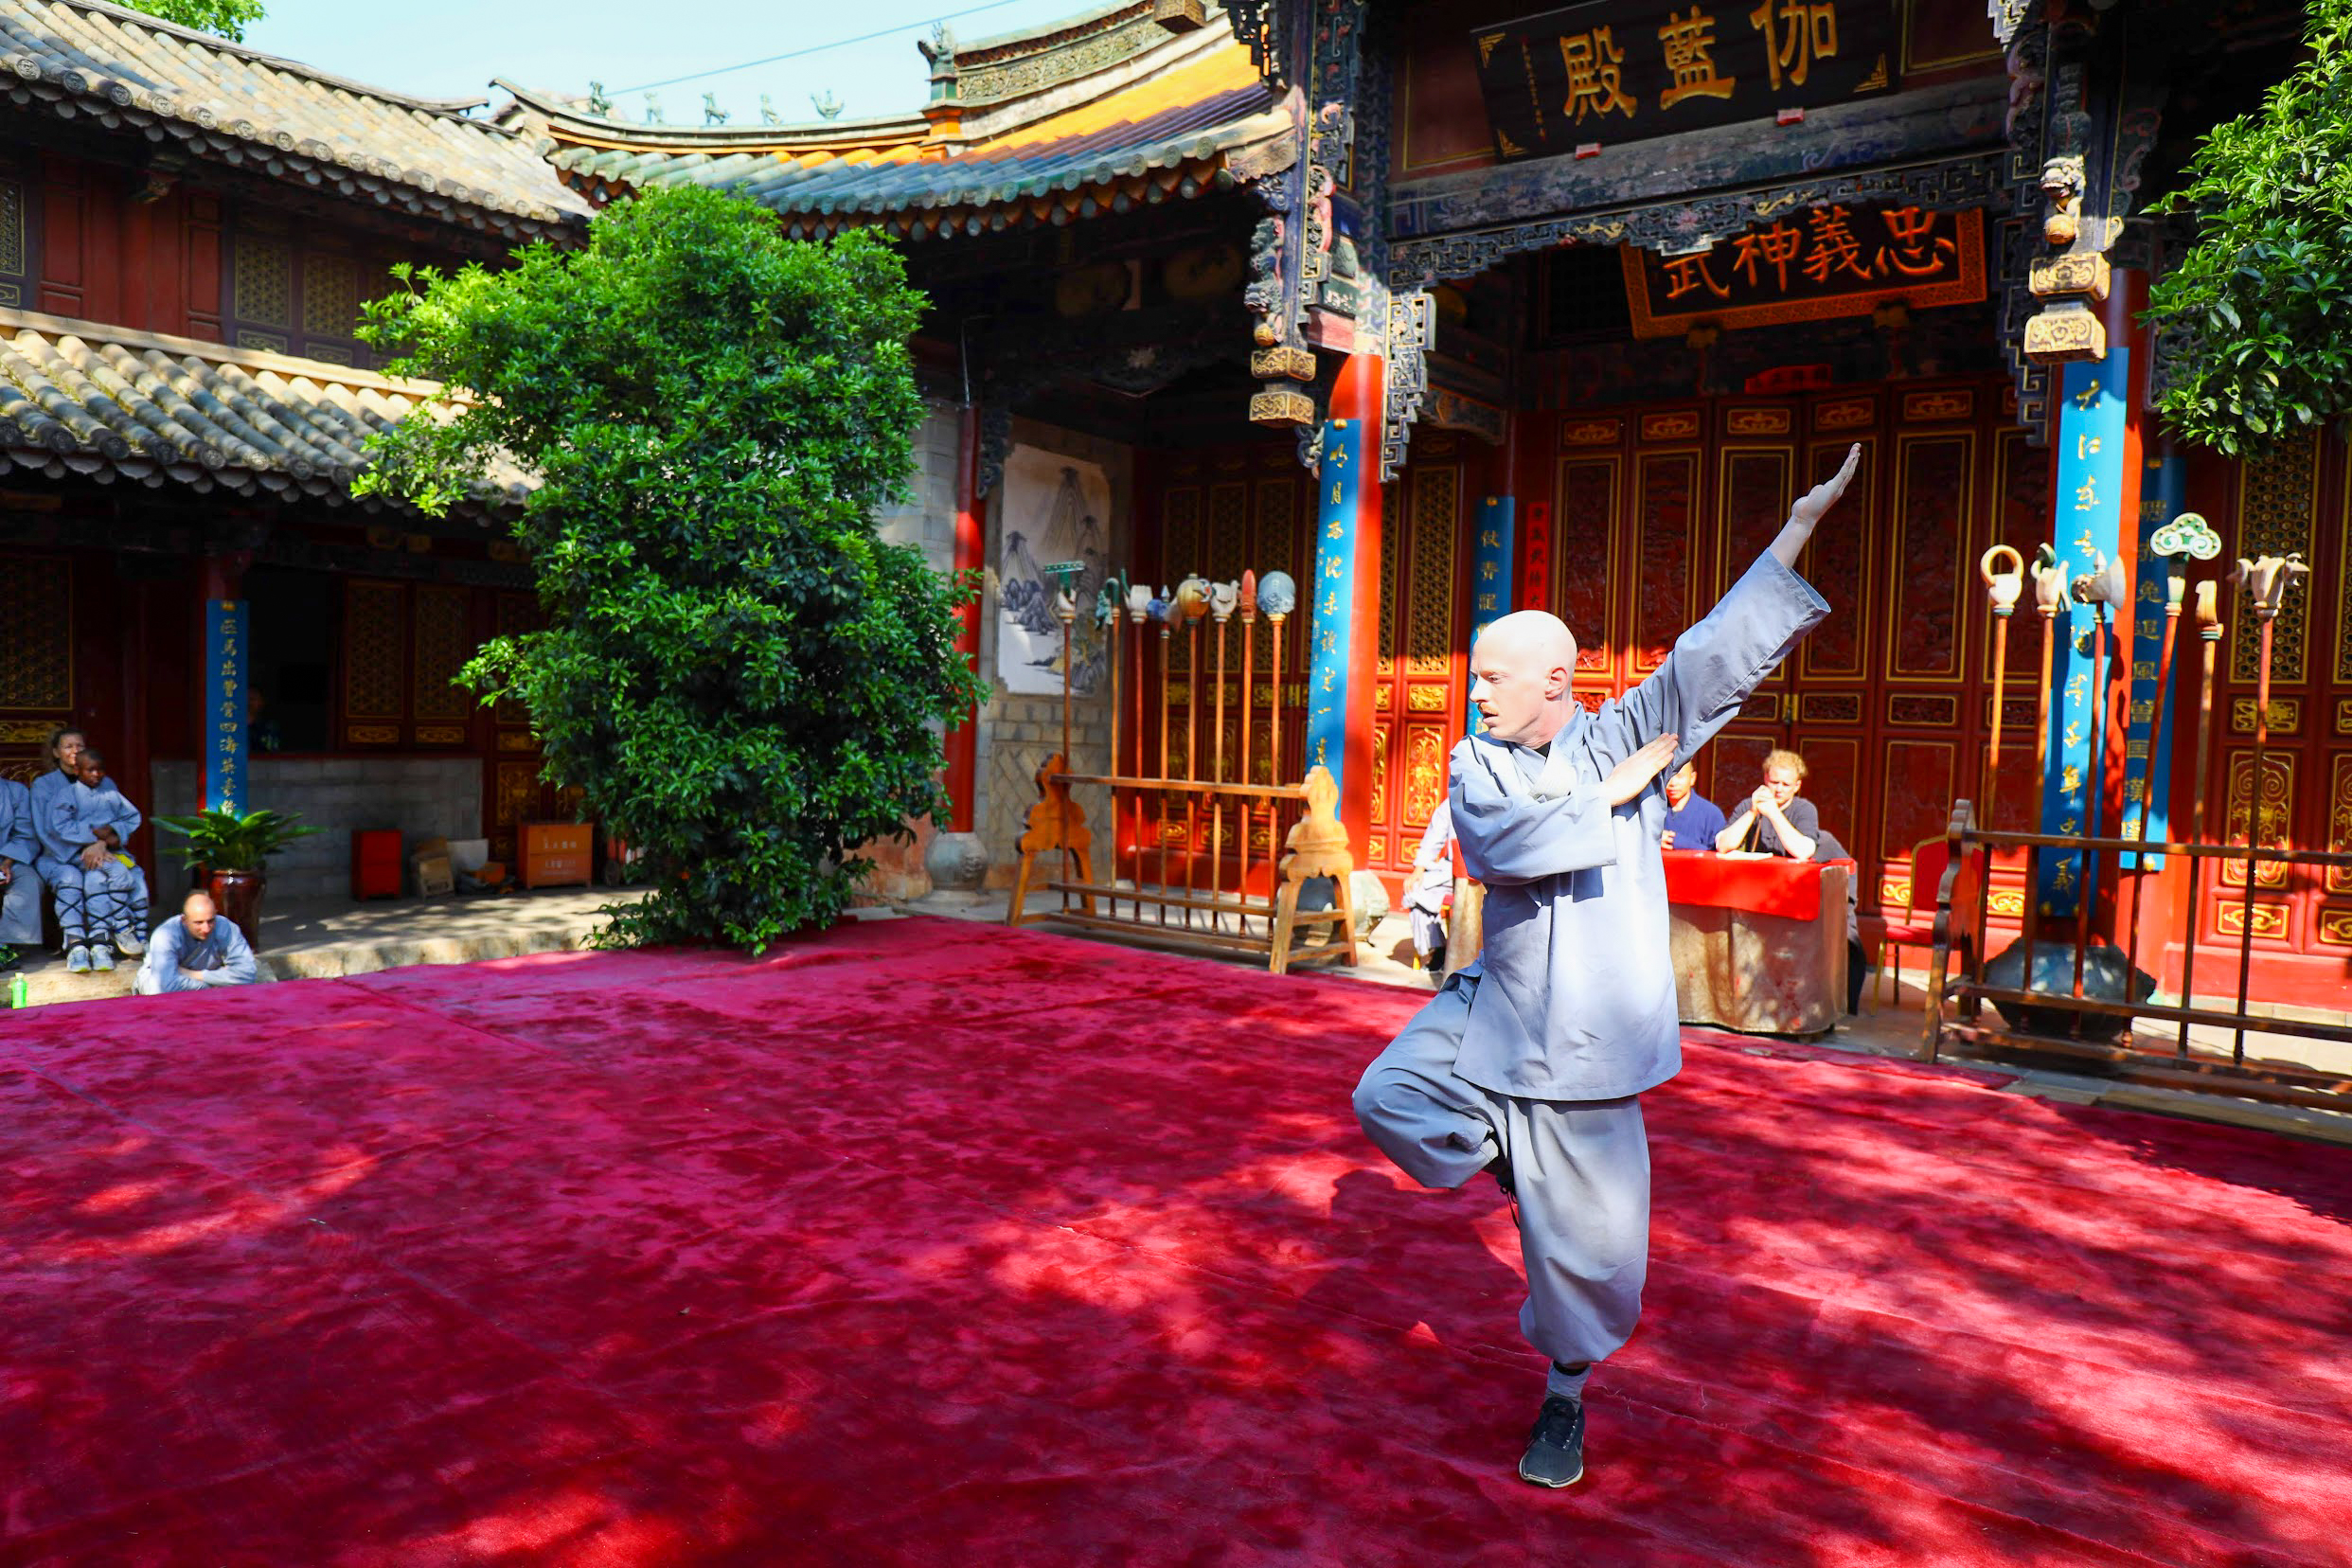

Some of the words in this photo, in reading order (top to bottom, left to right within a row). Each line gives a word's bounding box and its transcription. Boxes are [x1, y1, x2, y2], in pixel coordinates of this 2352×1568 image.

[1559, 0, 1839, 127] 伽藍殿
[1664, 205, 1956, 301] 忠義神武
